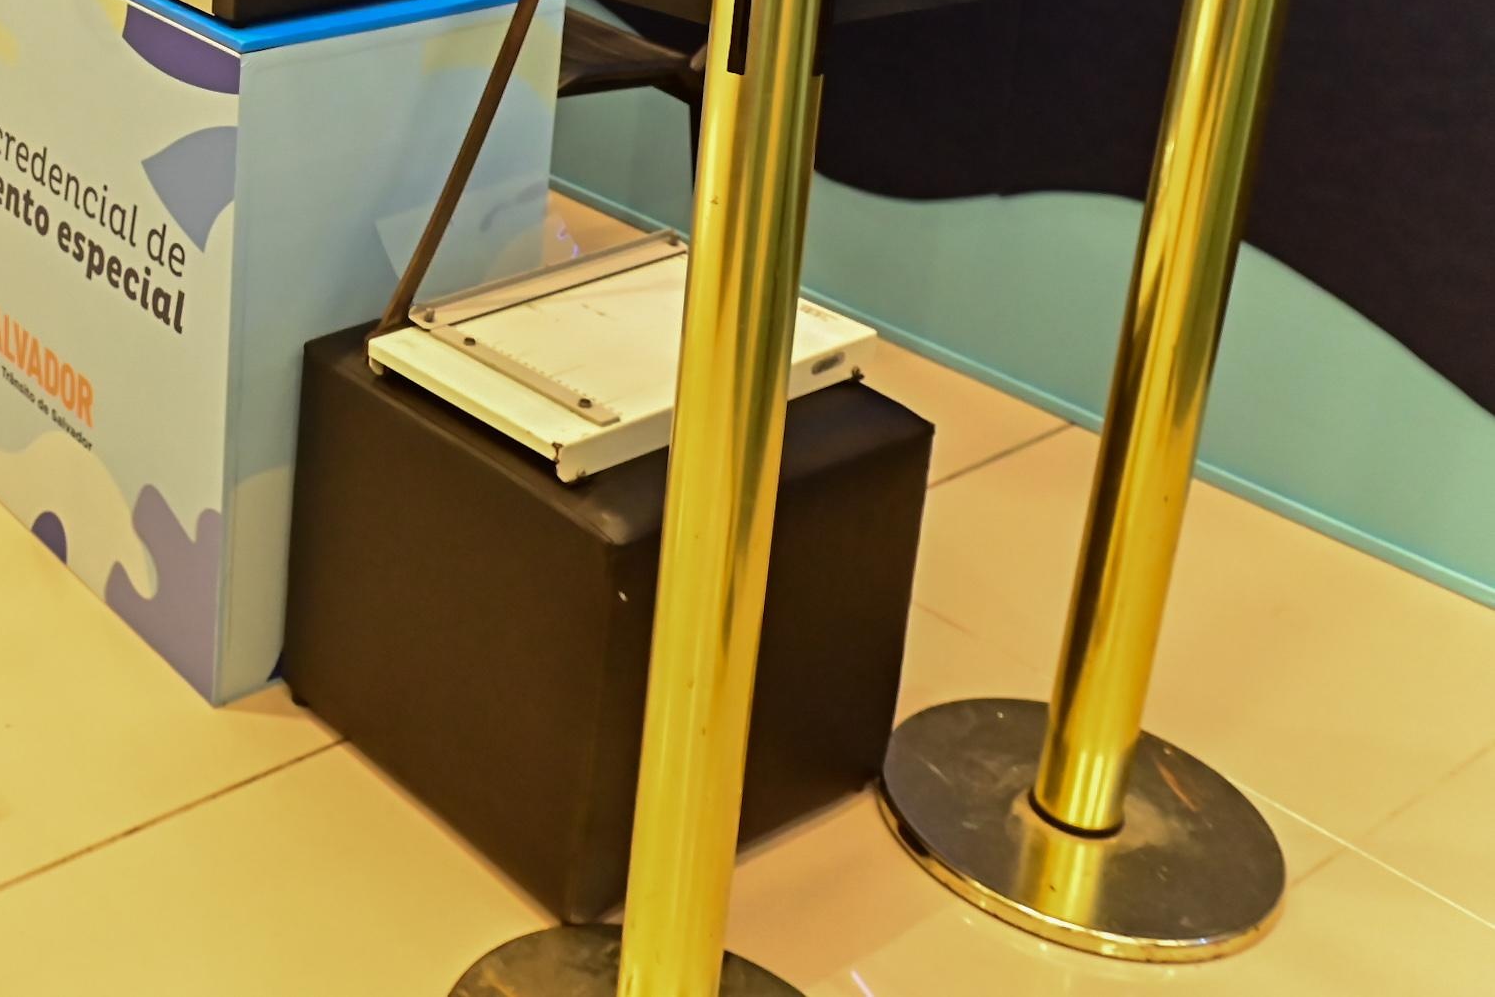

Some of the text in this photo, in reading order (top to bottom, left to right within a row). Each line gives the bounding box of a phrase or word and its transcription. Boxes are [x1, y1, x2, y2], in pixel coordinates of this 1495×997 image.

[56, 219, 186, 335] especial
[146, 223, 187, 278] de
[1, 364, 36, 404] Trânsito
[37, 398, 50, 416] de
[51, 408, 94, 452] Salvador
